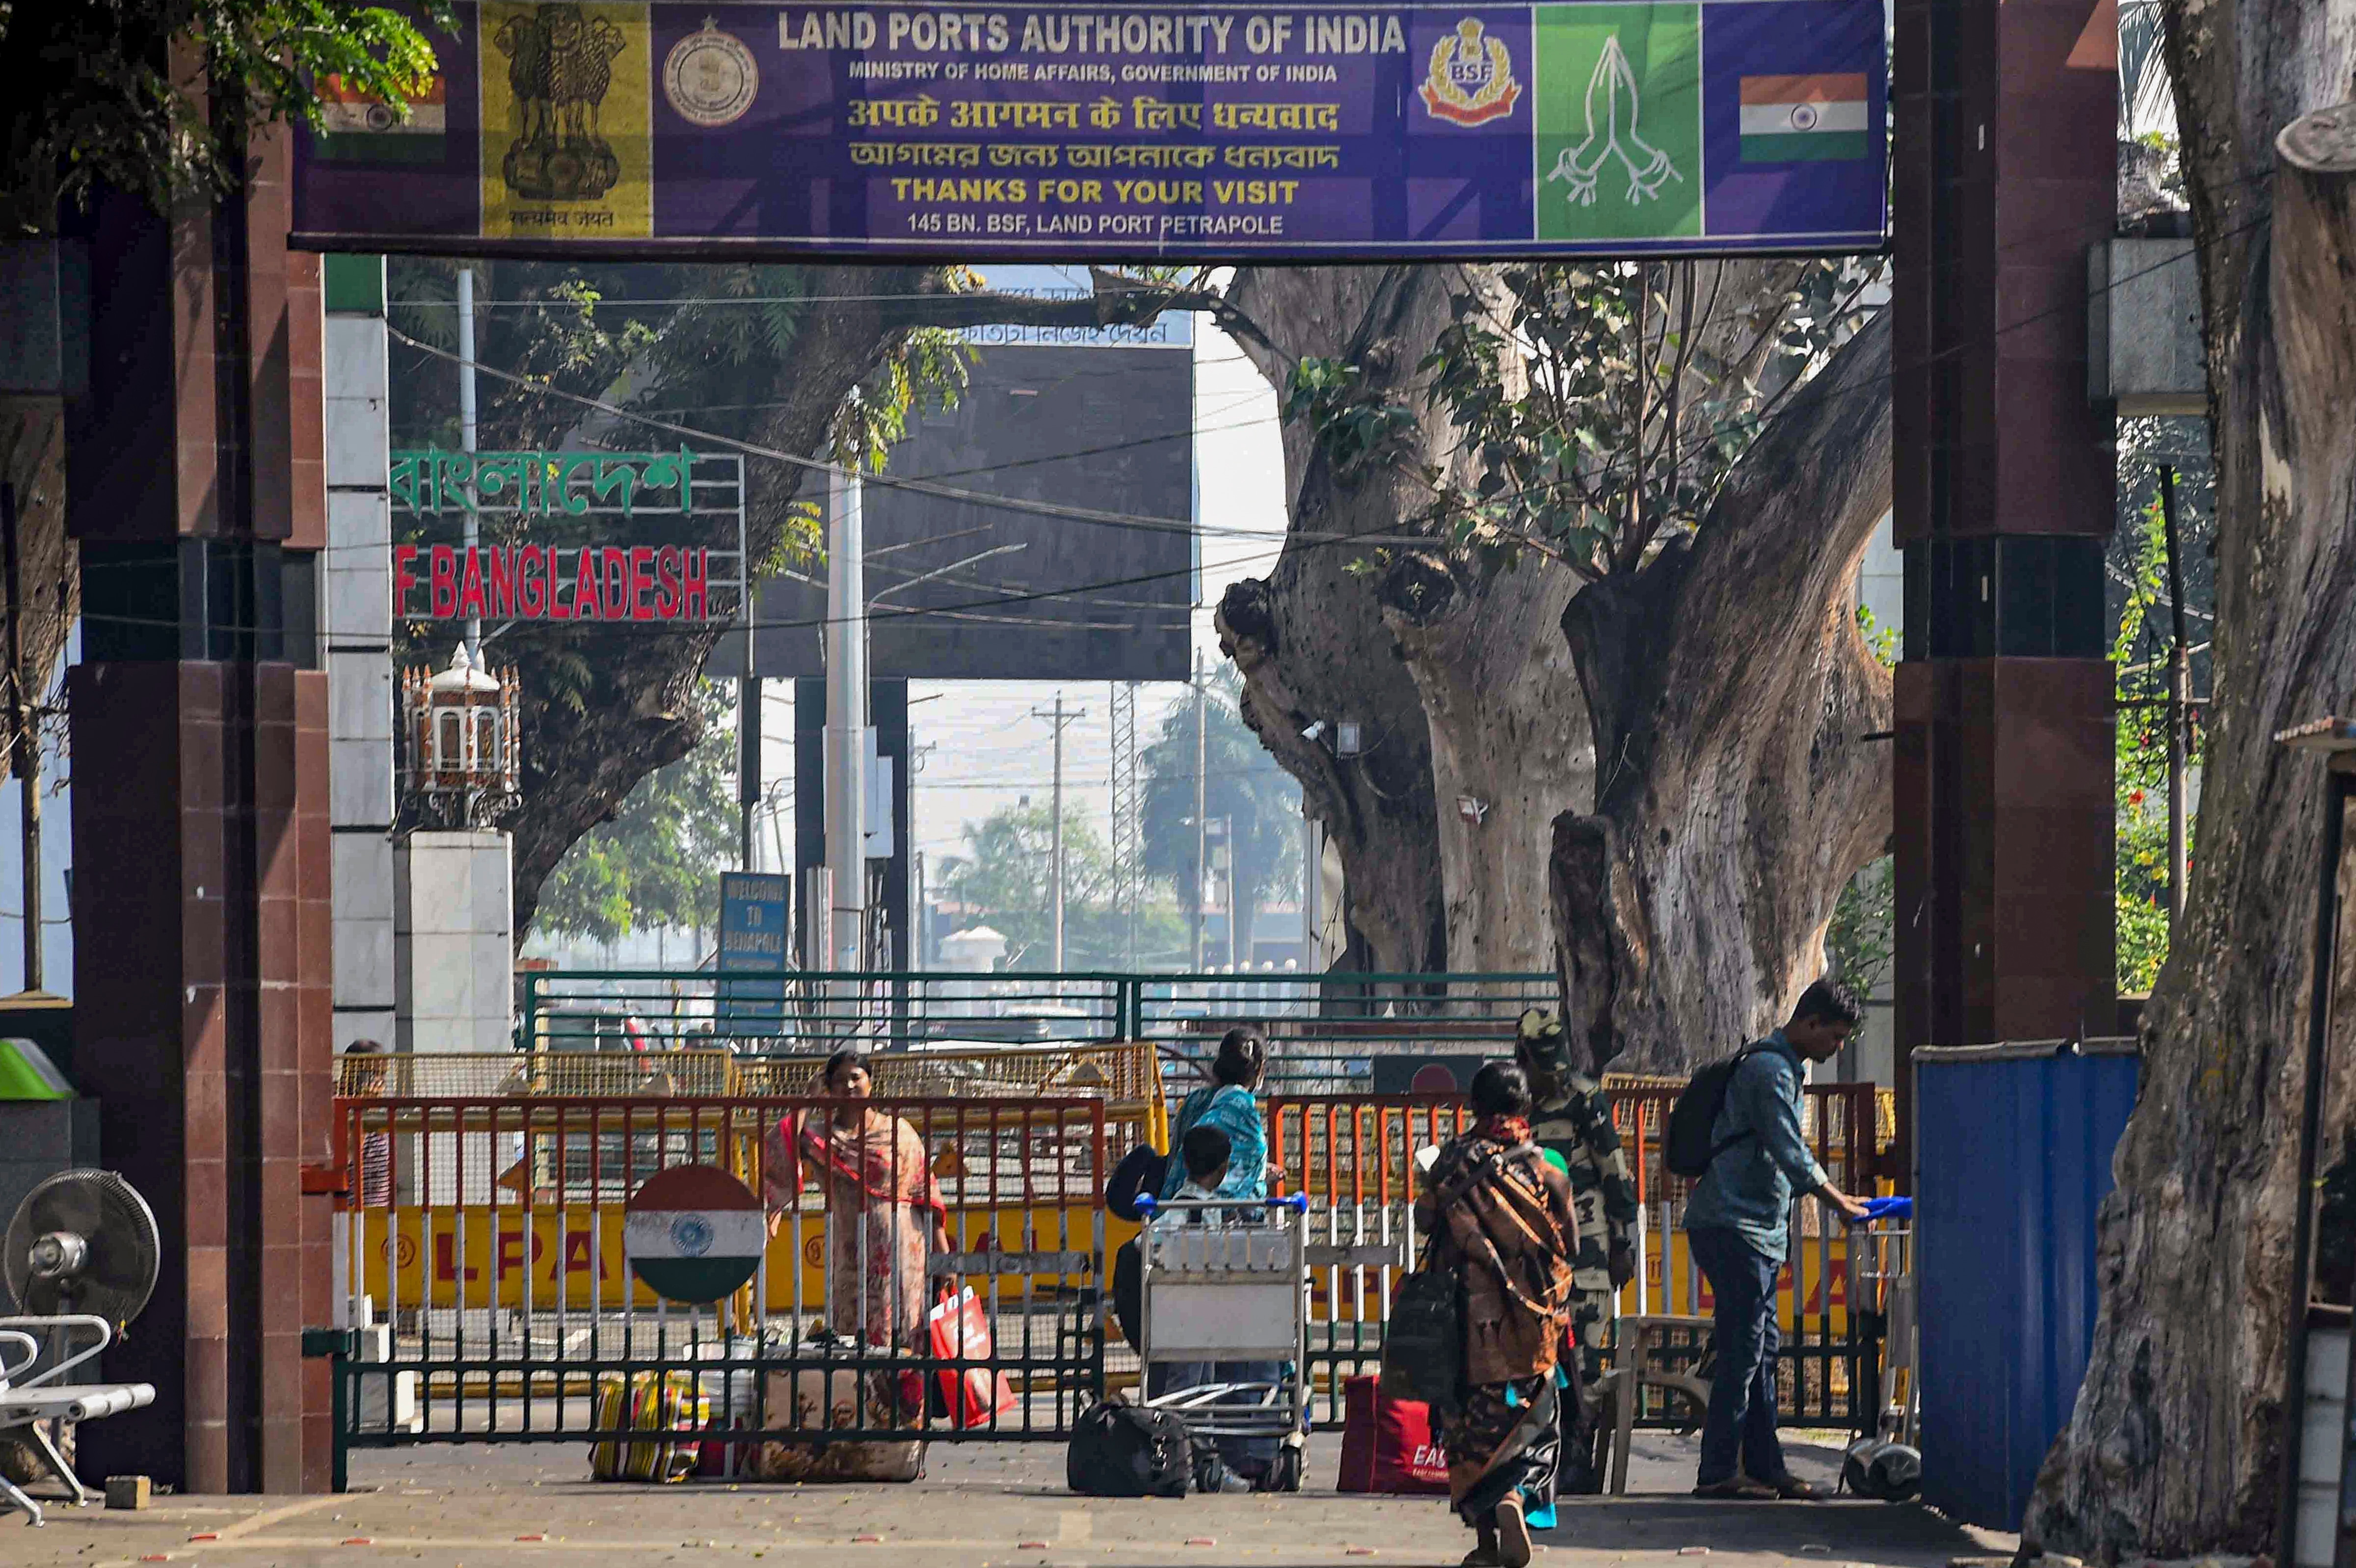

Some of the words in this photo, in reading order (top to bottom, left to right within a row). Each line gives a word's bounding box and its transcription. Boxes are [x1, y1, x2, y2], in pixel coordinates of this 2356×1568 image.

[778, 12, 877, 50] LAND
[889, 13, 1008, 52] PORTS
[1020, 14, 1233, 53] AUTHORITY
[1246, 16, 1294, 54] OF
[1306, 15, 1406, 53] INDIA
[849, 61, 939, 79] MINISTRY
[945, 62, 969, 80] OF
[975, 62, 1029, 80] HOME
[1034, 64, 1116, 85] AFFAIRS,
[1121, 64, 1251, 82] GOVERNMENT
[1256, 64, 1281, 82] OF
[1286, 64, 1338, 82] INDIA
[1451, 64, 1493, 81] BSF
[951, 101, 1080, 129] आगमन
[1088, 96, 1123, 129] के
[1132, 95, 1203, 131] लिए
[1213, 102, 1340, 132] धन्यवाद
[987, 143, 1059, 168] জন্য
[1224, 146, 1340, 169] ধন্যবাদ
[891, 177, 1027, 203] THANKS
[1038, 178, 1102, 203] FOR
[1113, 180, 1204, 204] YOUR
[1212, 180, 1299, 204] VISIT
[907, 213, 941, 233] 145
[947, 213, 981, 233] BN.
[987, 213, 1031, 236] BSF,
[1037, 214, 1093, 234] LAND
[1098, 215, 1153, 235] PORT
[1162, 215, 1284, 235] PETRAPOLE
[391, 442, 698, 517] বাংলাদেশ
[430, 544, 708, 620] BANGLADESH
